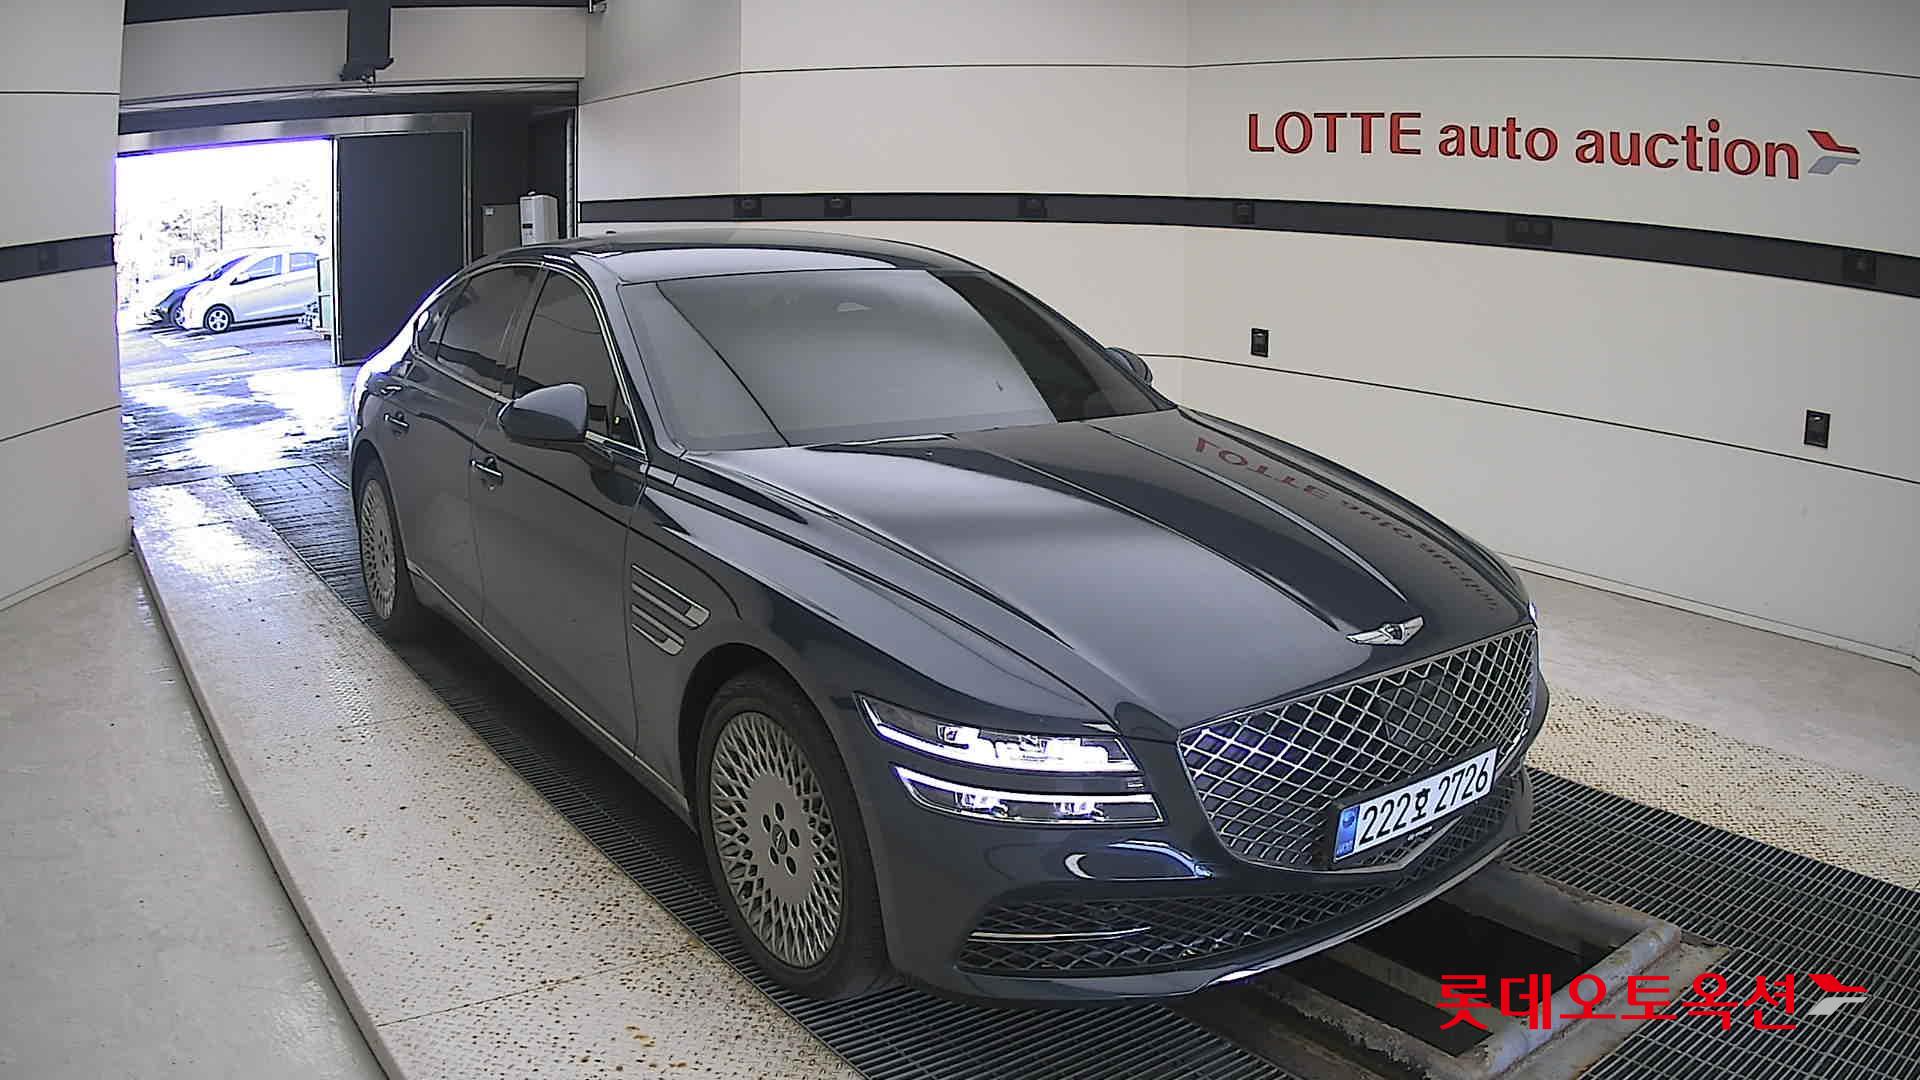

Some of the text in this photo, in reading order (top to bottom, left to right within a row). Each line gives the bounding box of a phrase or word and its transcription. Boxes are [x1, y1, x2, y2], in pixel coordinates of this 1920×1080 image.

[1248, 111, 1800, 179] LOTTE auto auction
[1435, 757, 1489, 813] 2726
